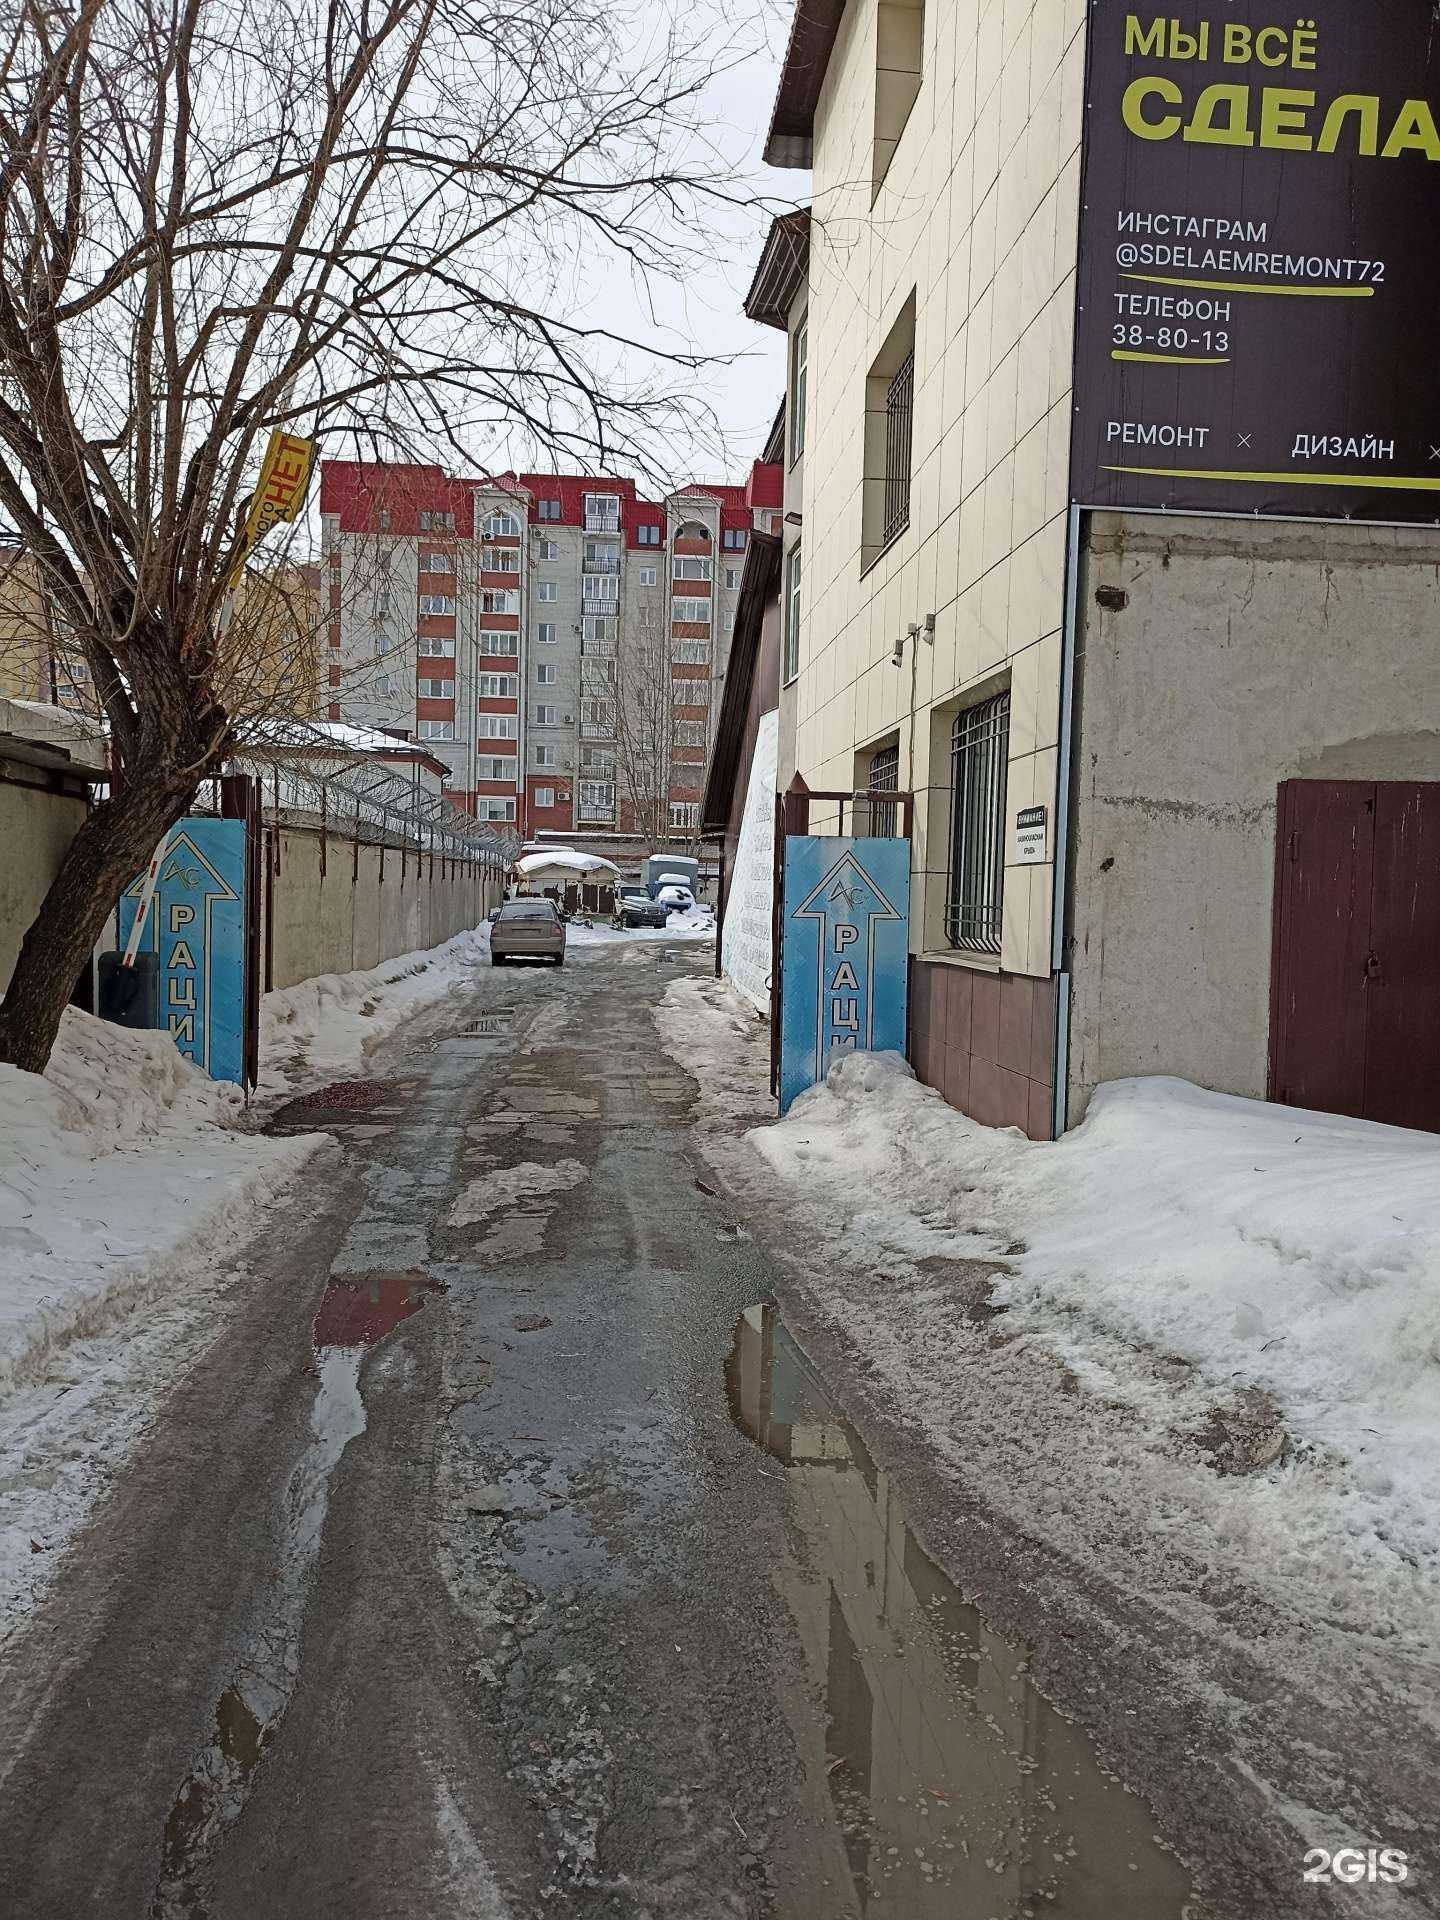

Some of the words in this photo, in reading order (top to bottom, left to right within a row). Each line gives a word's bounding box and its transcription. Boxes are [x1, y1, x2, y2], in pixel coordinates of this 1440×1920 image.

[1124, 15, 1209, 61] МЫ
[1223, 19, 1318, 70] ВСЁ
[1122, 76, 1440, 161] СДЕЛА
[1116, 211, 1267, 243] ИНСТАГРАМ
[1116, 243, 1386, 282] @SDELAEMREMONT72
[1114, 293, 1231, 322] ТЕЛЕФОН
[1112, 324, 1229, 351] 38-80-13
[1107, 421, 1209, 448] РЕМОНТ
[1291, 433, 1395, 461] ДИЗАЙН
[265, 435, 306, 505] НЕТ
[167, 905, 196, 1060] РАЦИ
